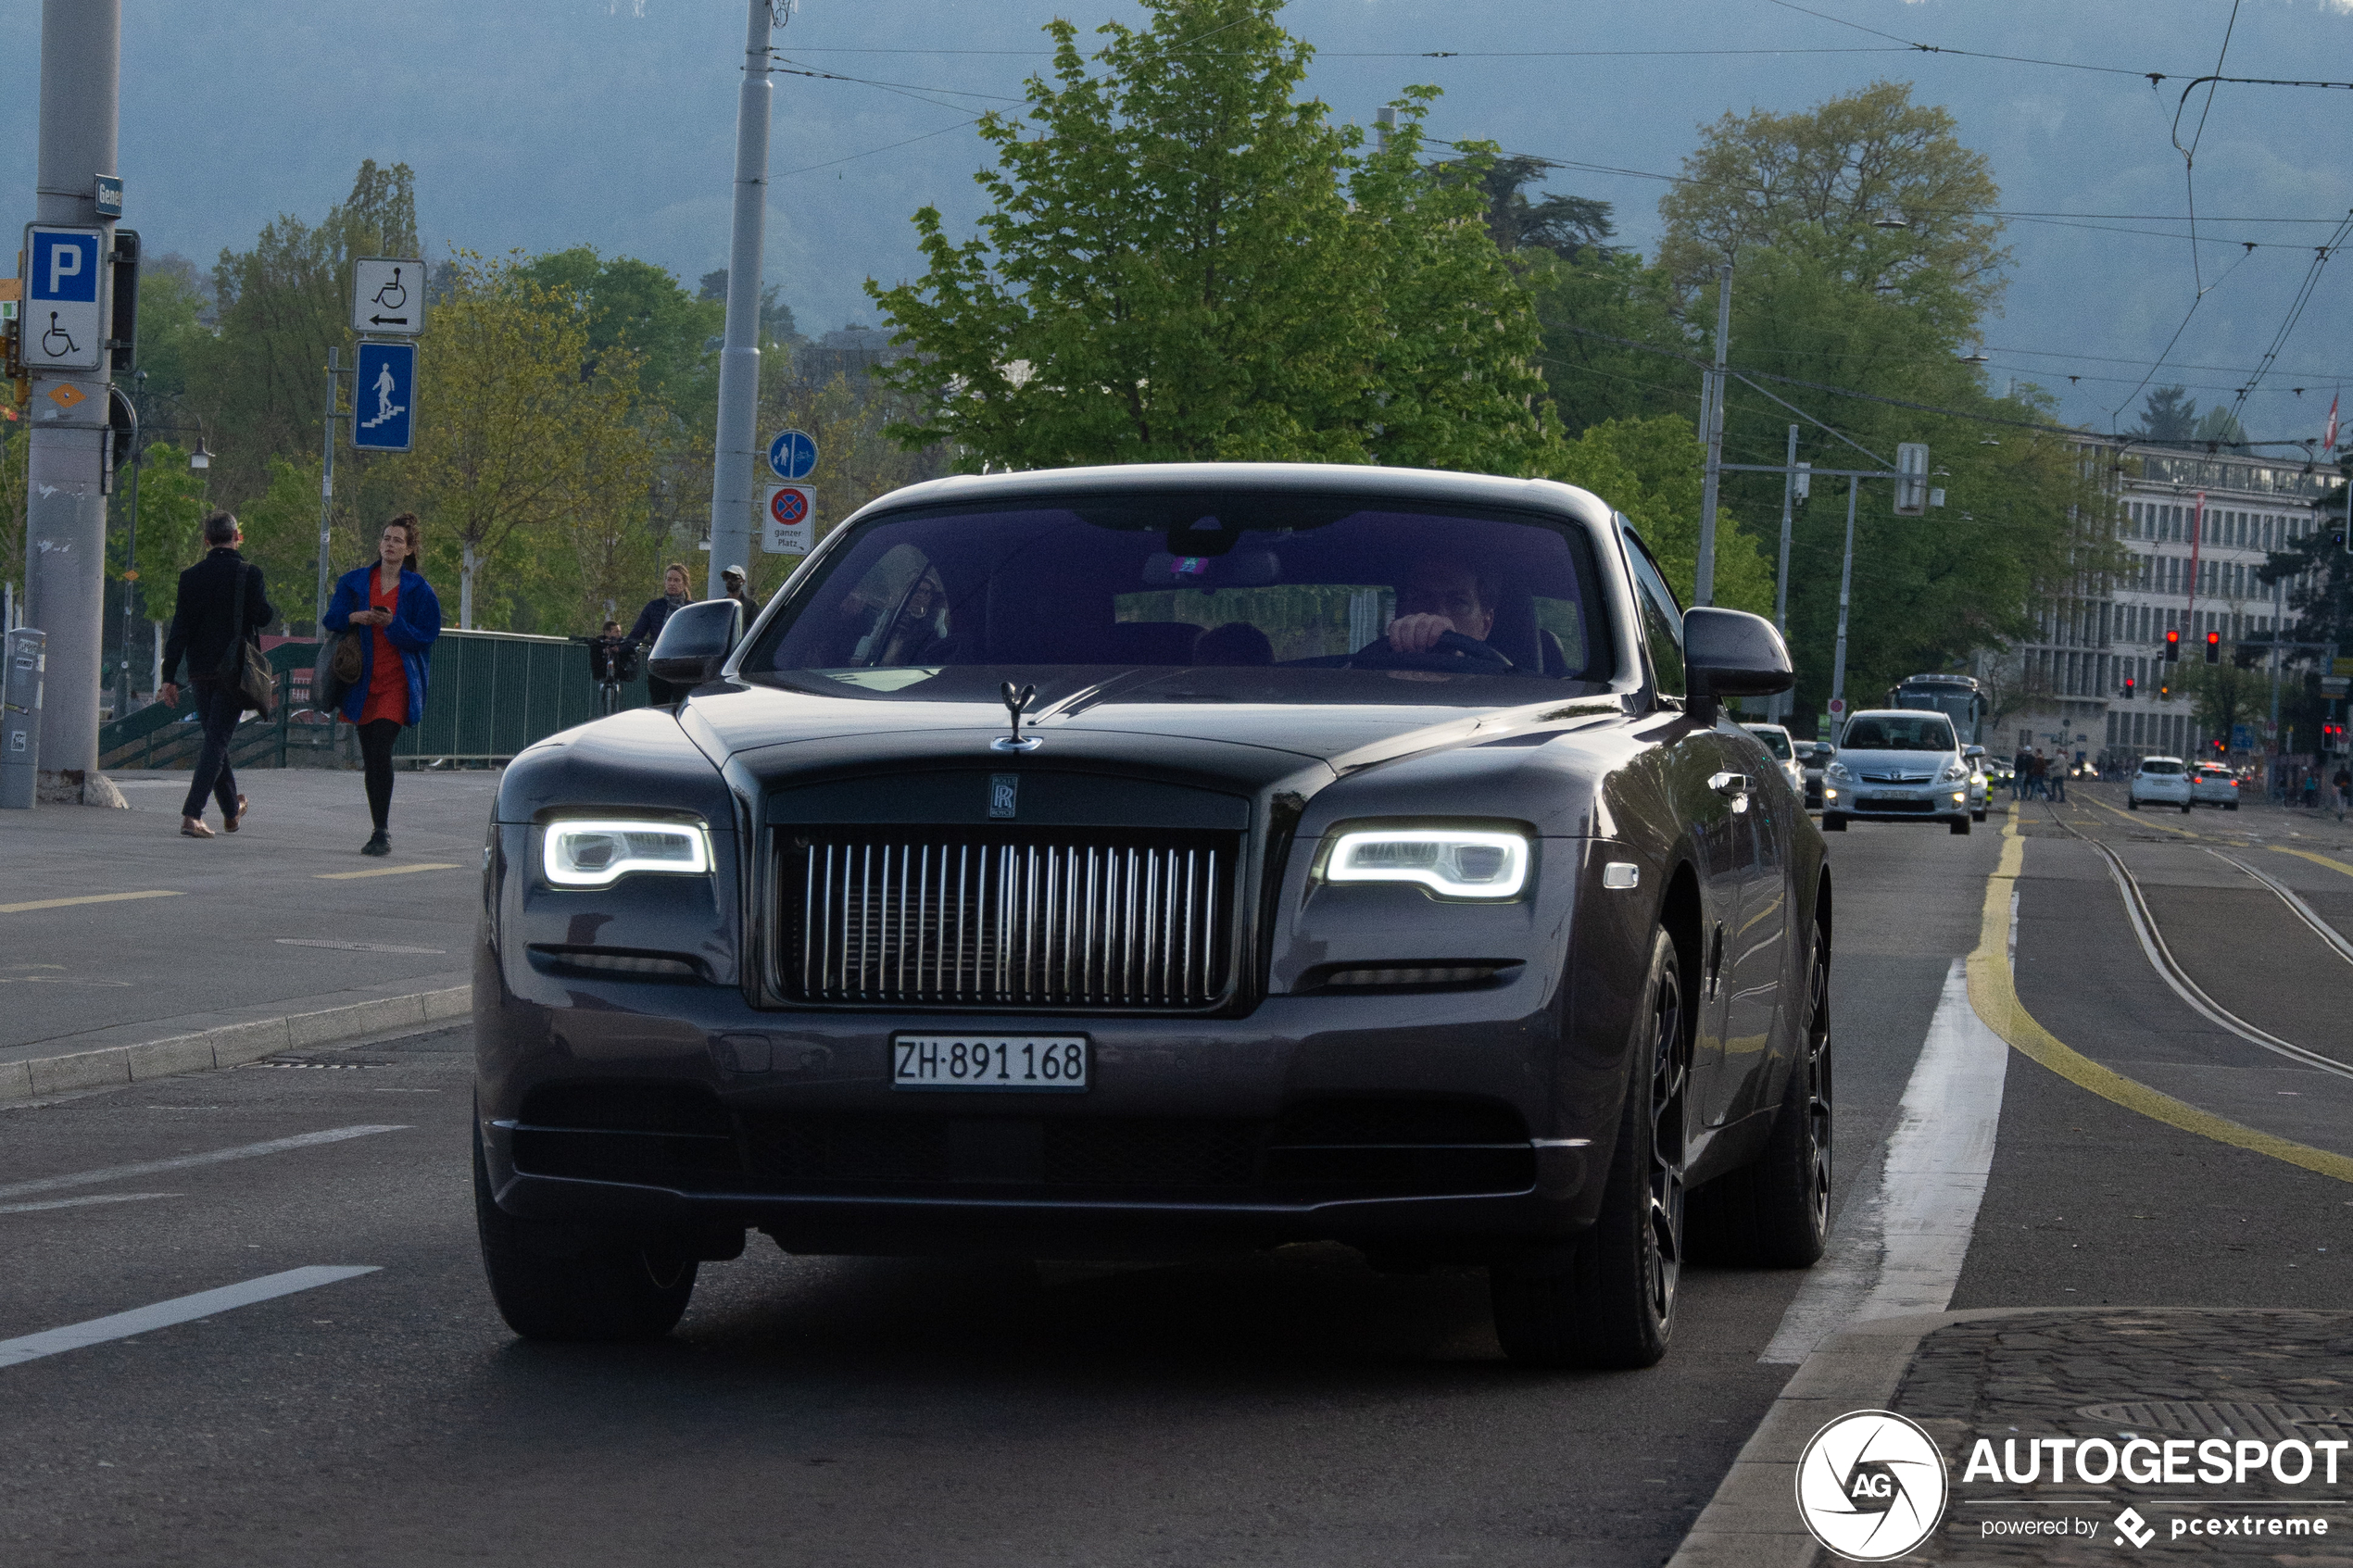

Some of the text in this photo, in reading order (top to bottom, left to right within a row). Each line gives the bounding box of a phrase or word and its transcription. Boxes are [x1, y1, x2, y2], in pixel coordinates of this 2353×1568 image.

[49, 244, 82, 293] P
[774, 529, 801, 537] ganzer
[777, 538, 798, 547] Platz
